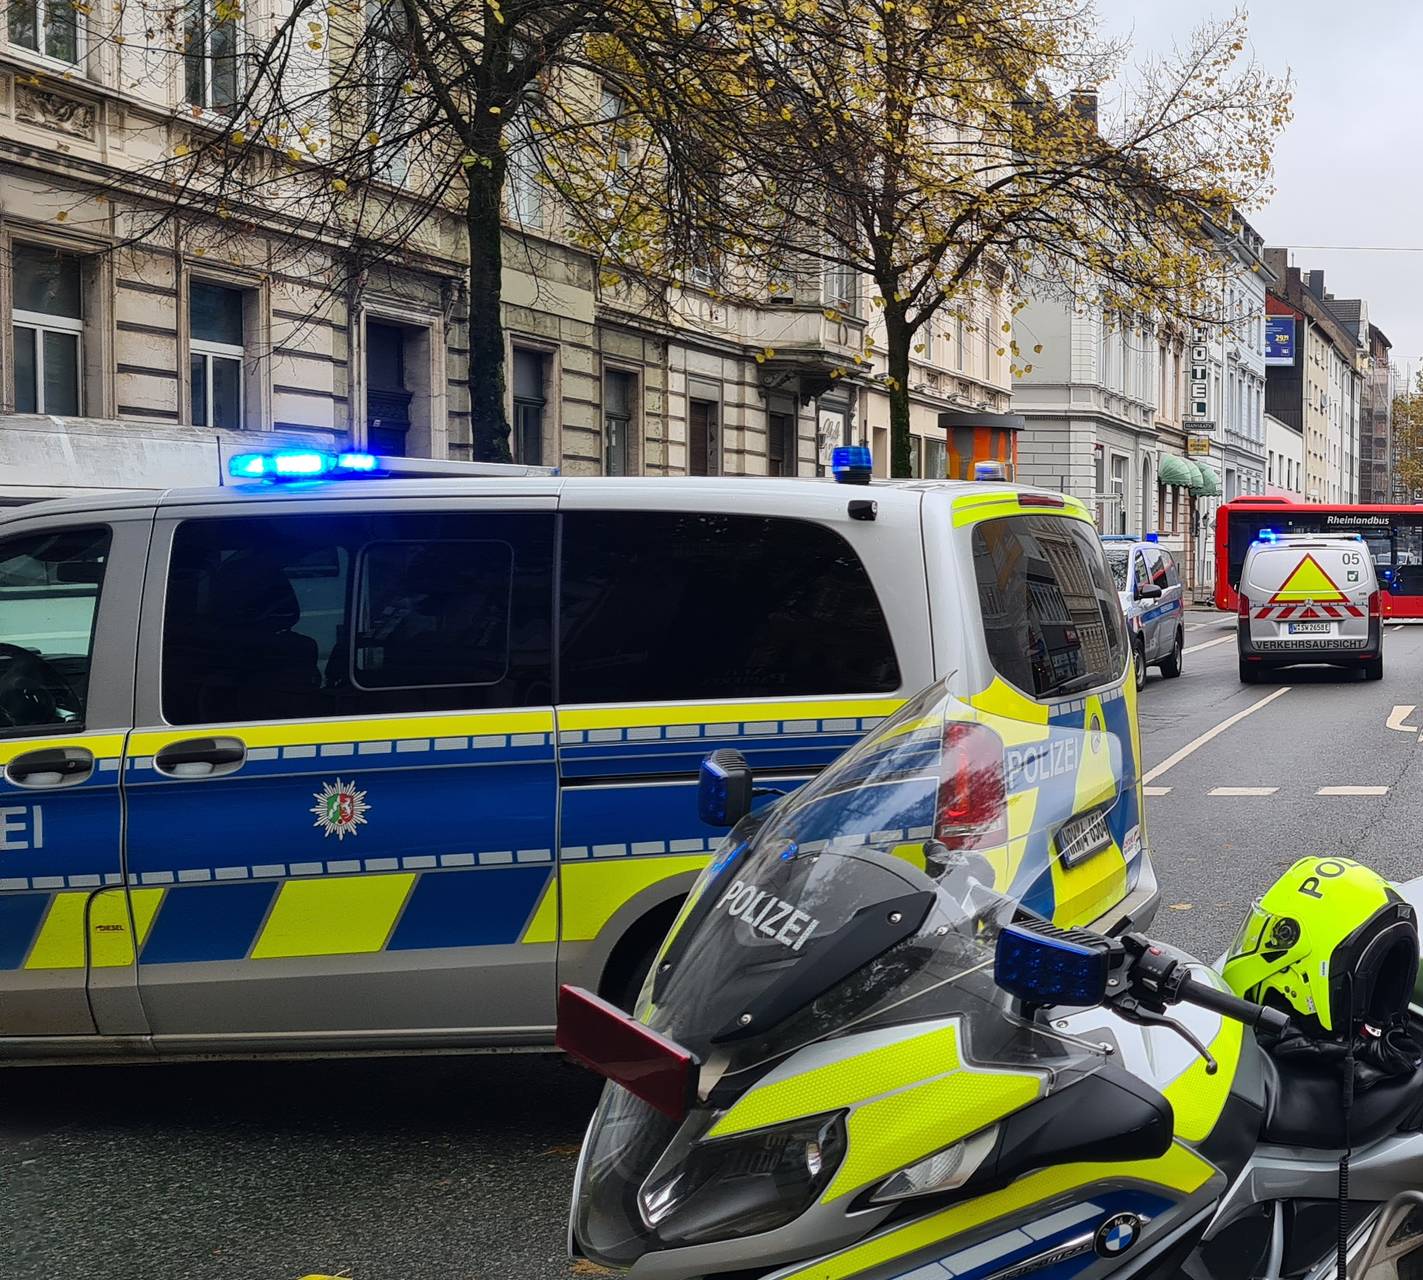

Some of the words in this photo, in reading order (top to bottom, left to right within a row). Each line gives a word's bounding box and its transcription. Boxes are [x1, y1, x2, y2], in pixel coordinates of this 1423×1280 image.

[1191, 327, 1207, 417] HOTEL
[1327, 515, 1390, 526] Rheinlandbus
[1342, 553, 1360, 566] 05
[1256, 640, 1363, 649] VERKEHRSAUFSICHT
[1006, 737, 1079, 789] POLIZEI
[716, 880, 820, 951] POLIZEI
